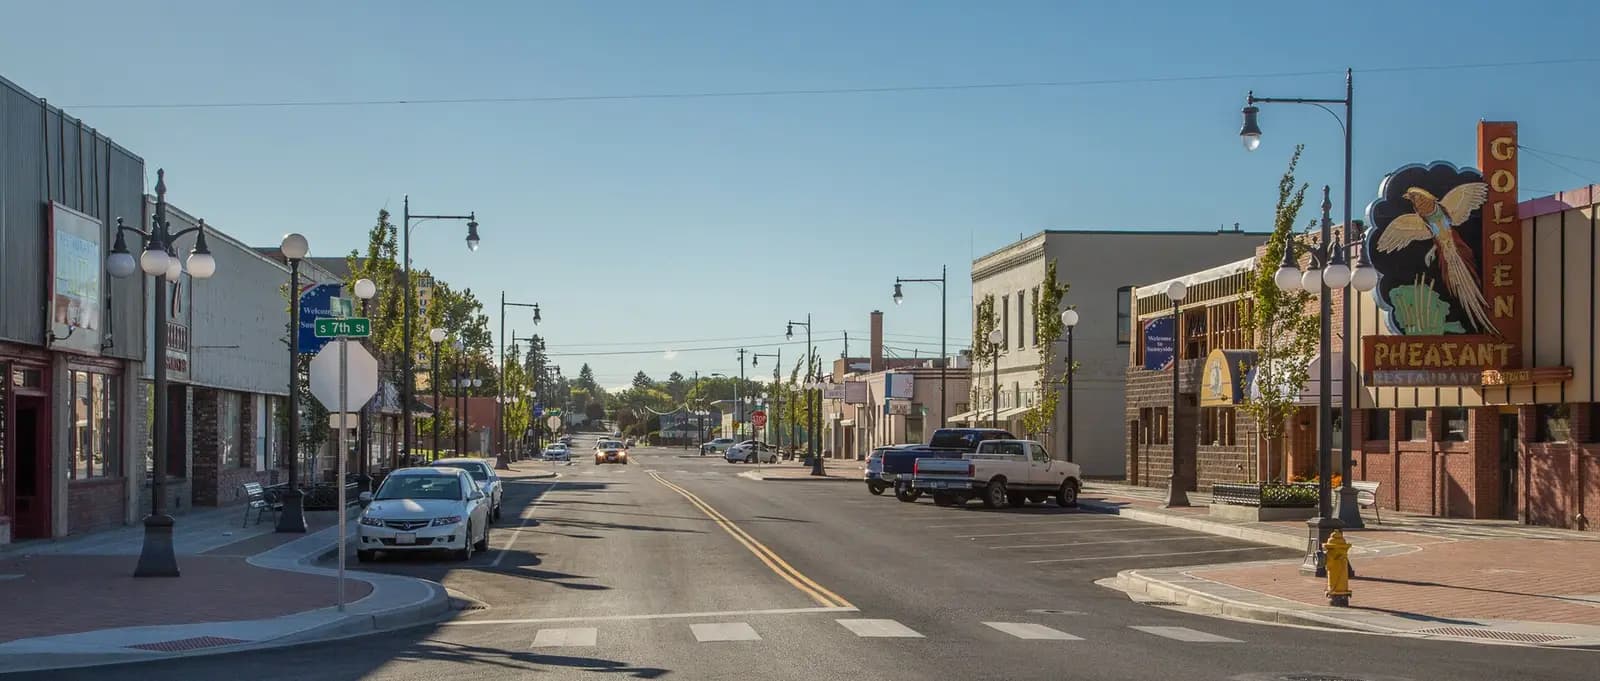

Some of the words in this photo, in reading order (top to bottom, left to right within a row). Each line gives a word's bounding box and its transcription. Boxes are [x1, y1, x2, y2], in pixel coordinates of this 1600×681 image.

[1490, 136, 1516, 319] GOLDEN
[303, 306, 331, 315] Welcom
[331, 322, 351, 333] 7th
[355, 323, 365, 333] St
[1374, 342, 1515, 367] PHEASANT
[1374, 371, 1479, 384] RESTAURANT
[752, 415, 767, 423] STOP
